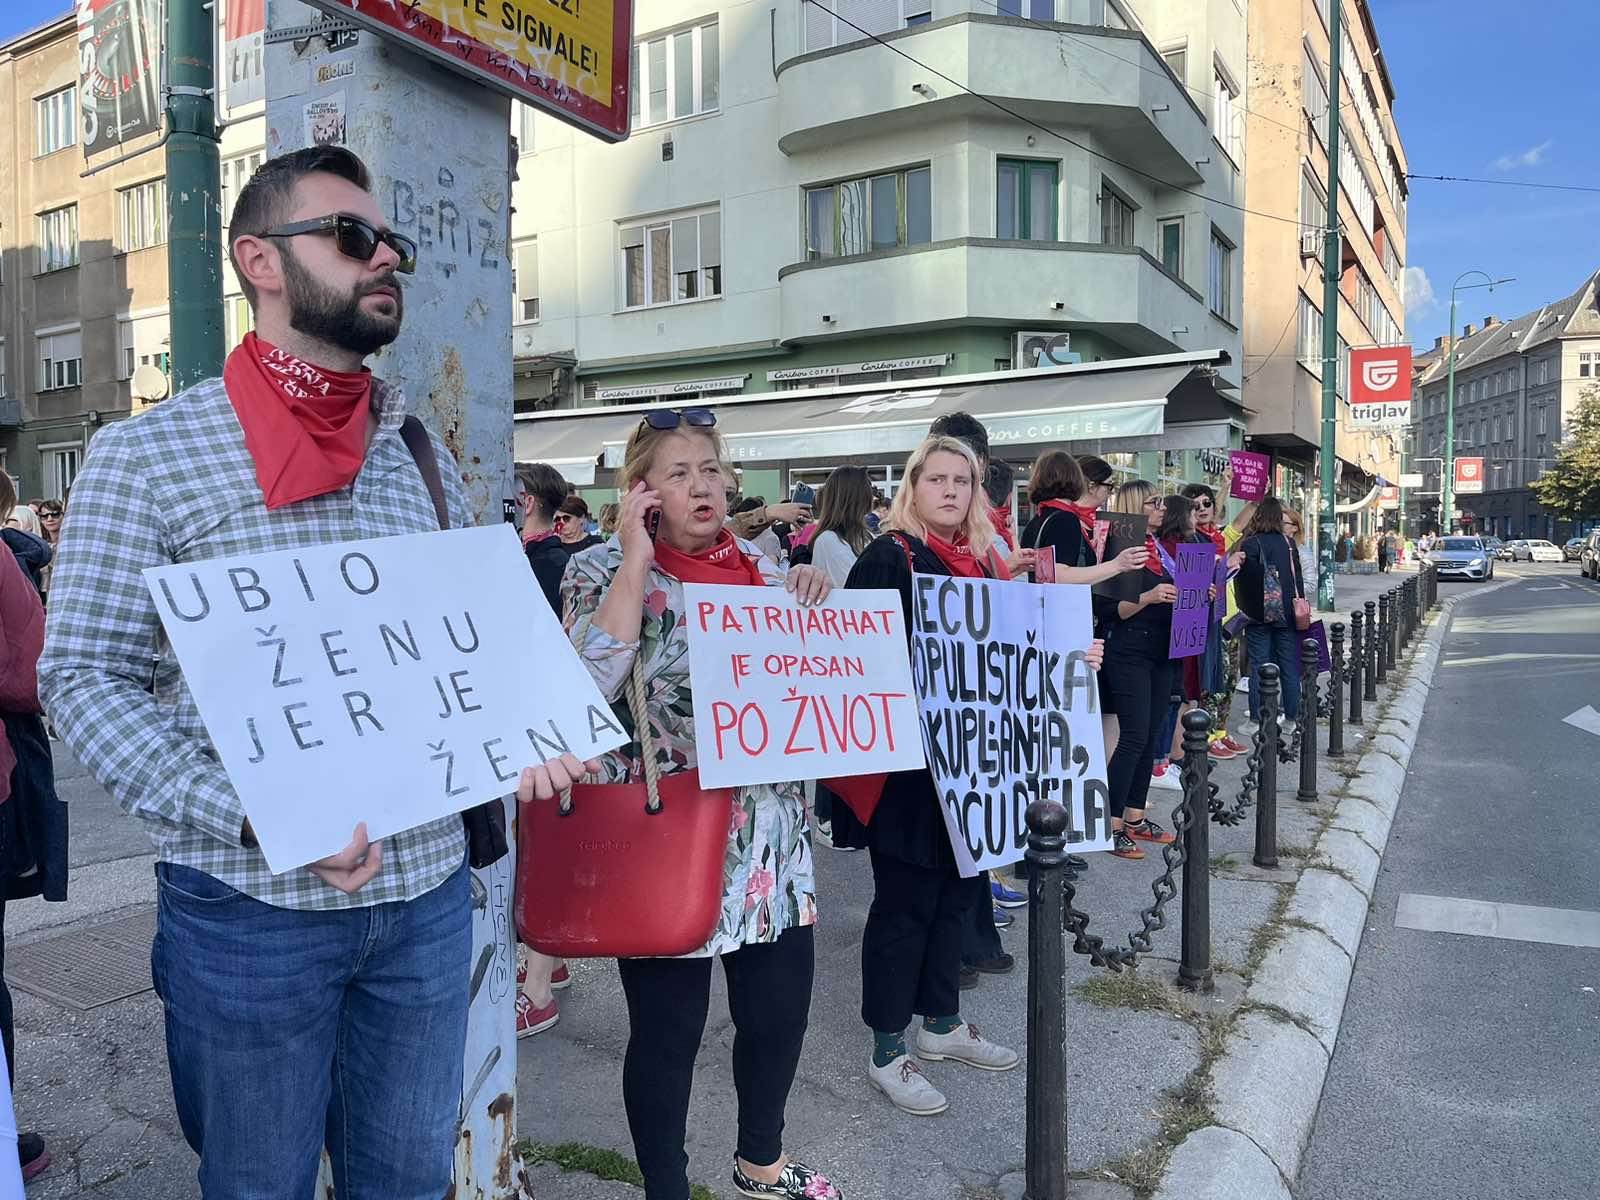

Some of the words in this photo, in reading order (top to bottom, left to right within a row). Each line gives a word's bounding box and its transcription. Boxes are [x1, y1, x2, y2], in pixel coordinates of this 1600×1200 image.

[501, 1, 598, 77] SIGNALE!
[673, 384, 703, 393] Caribou
[774, 371, 808, 379] Caribou
[861, 362, 897, 372] Caribou
[1352, 404, 1408, 422] triglav
[158, 552, 380, 622] UBIO
[697, 601, 897, 649] PATRIJARHAT
[1172, 620, 1208, 649] VIŠE
[256, 611, 480, 688] ŽENU
[731, 653, 751, 688] JE
[764, 653, 865, 679] OPASAN
[247, 690, 385, 763] JER
[434, 670, 483, 719] JE
[712, 700, 769, 762] PO
[781, 685, 907, 756] ŽIVOT
[427, 704, 623, 797] ŽENA
